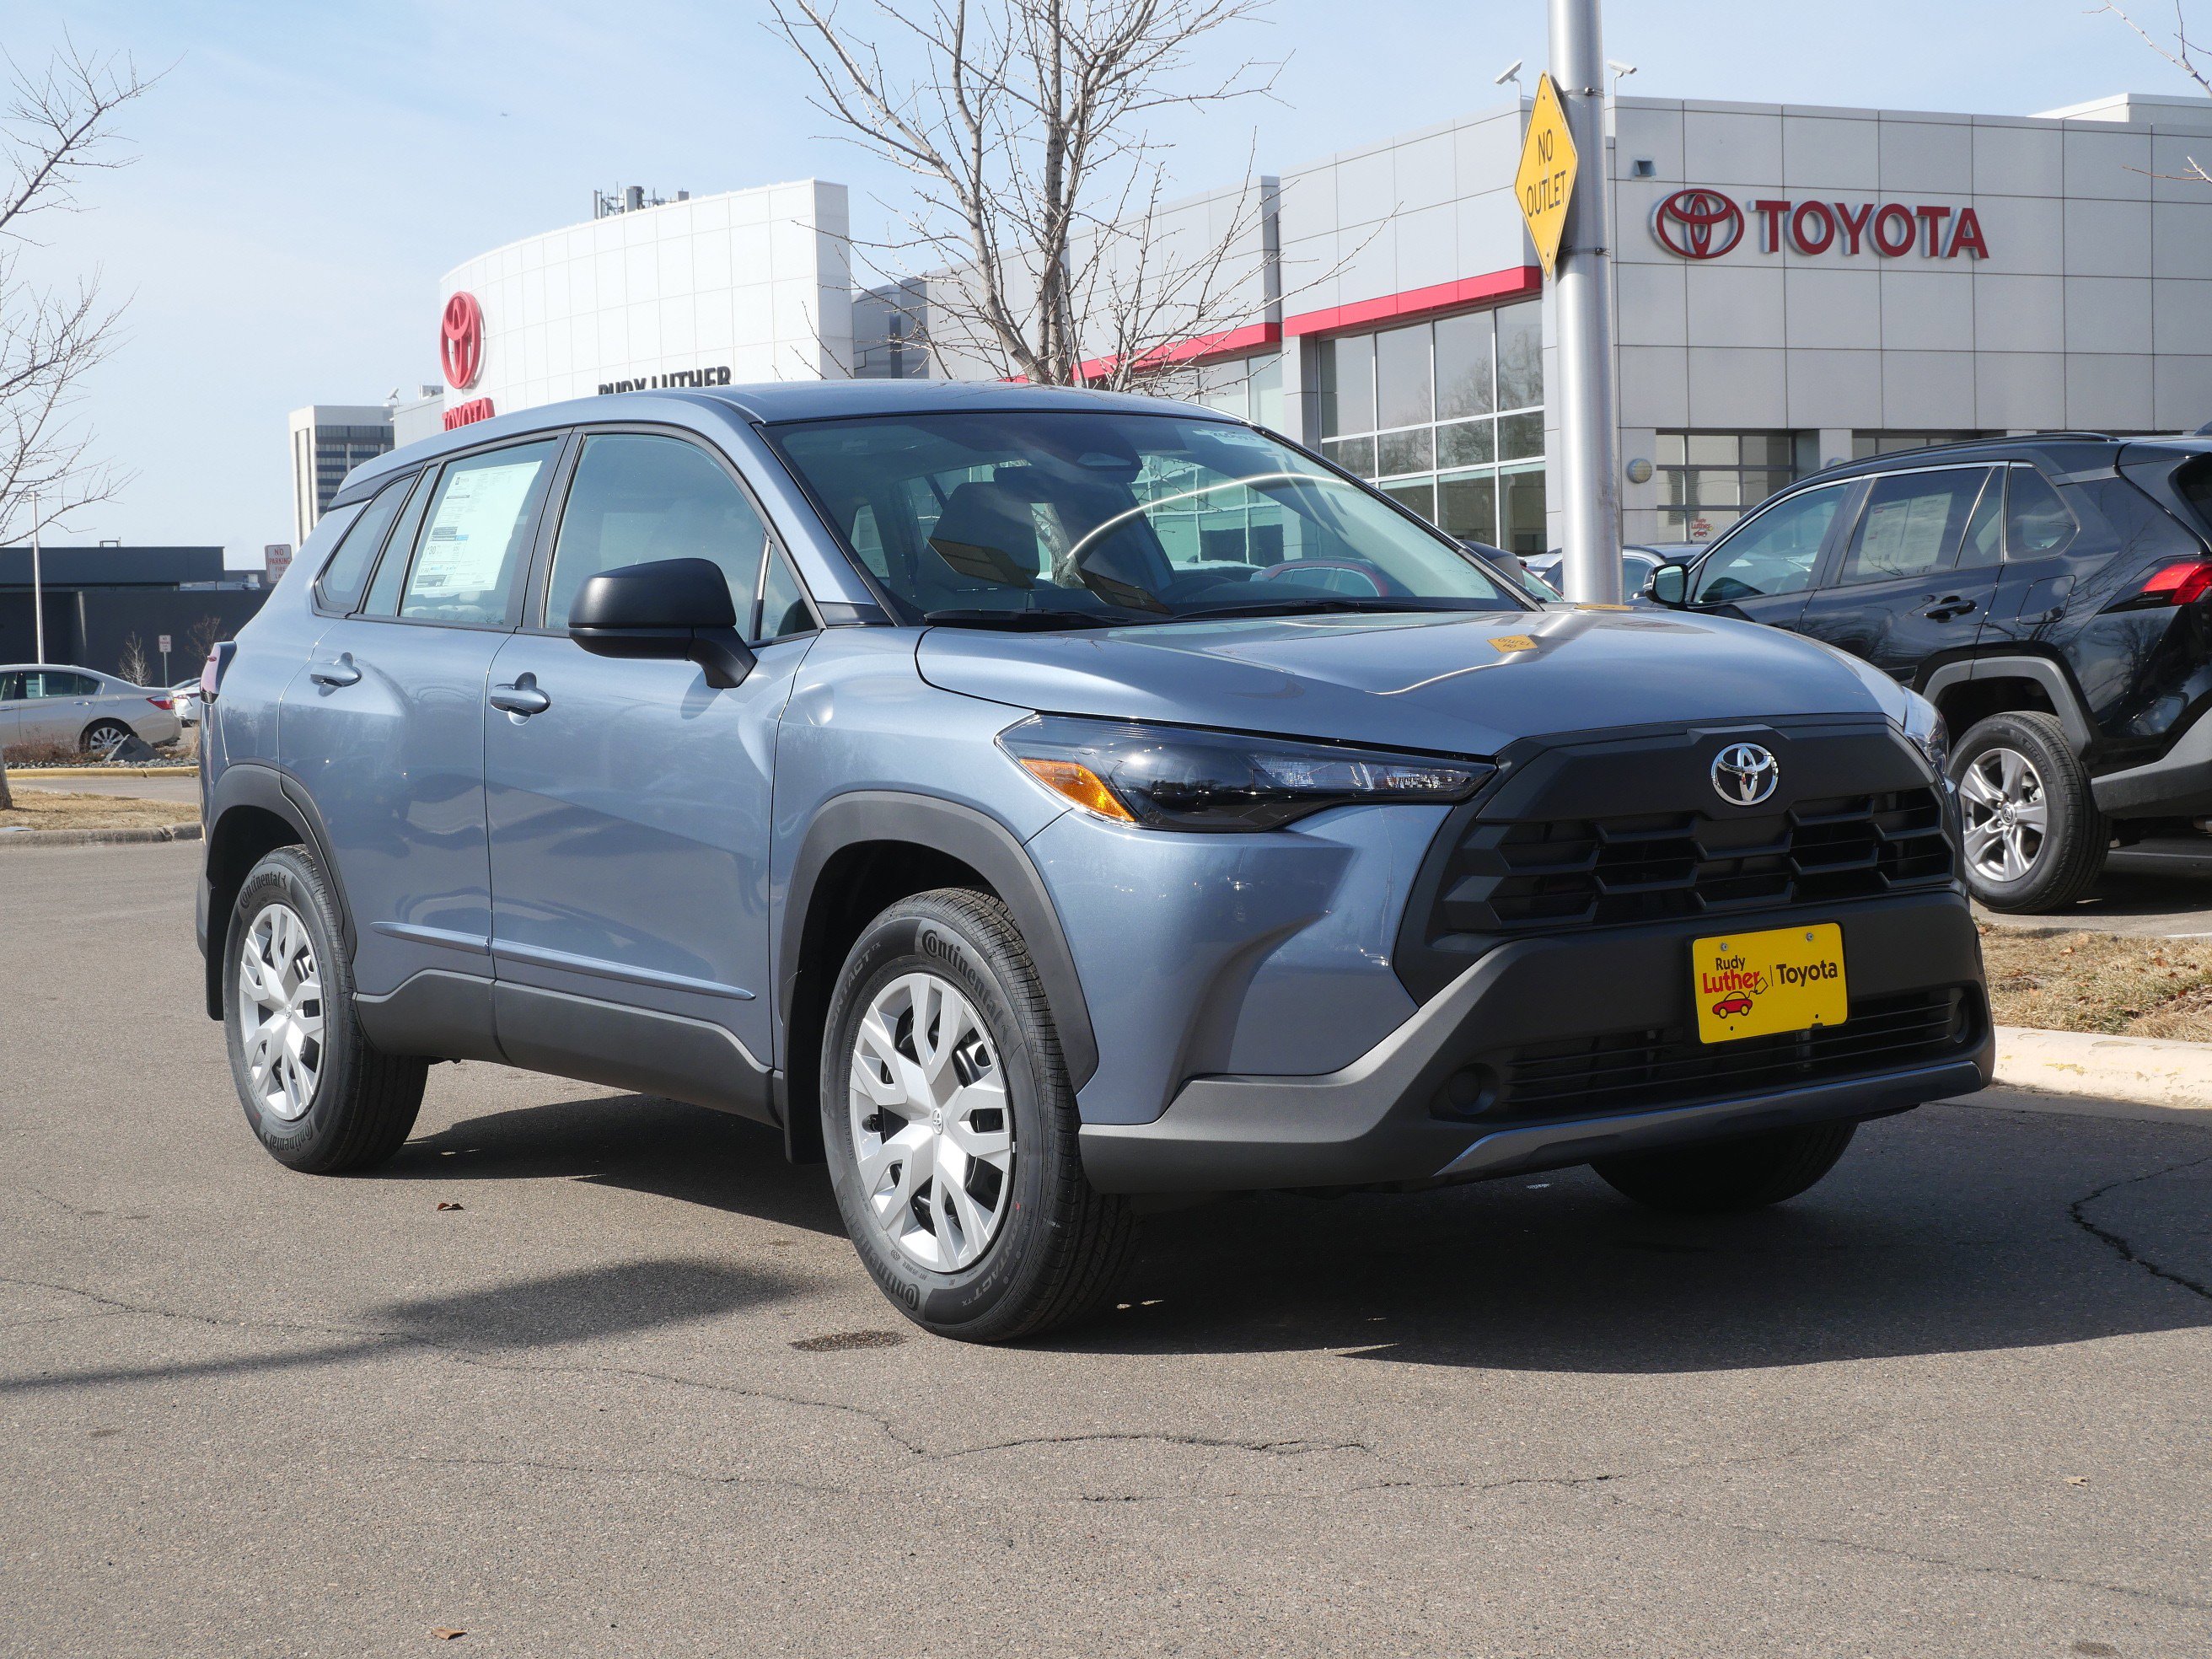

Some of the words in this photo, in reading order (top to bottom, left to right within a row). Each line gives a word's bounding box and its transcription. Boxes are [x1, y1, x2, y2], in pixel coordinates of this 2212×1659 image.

[1538, 129, 1554, 166] NO
[1527, 170, 1566, 217] OUTLET
[1752, 200, 1989, 259] TOYOTA
[442, 397, 495, 432] TOYOTA
[274, 548, 284, 556] NO
[239, 871, 282, 910] Continental
[921, 929, 1005, 1025] Continental
[1715, 955, 1746, 971] Rudy
[1775, 959, 1839, 987] Toyota
[1702, 969, 1760, 994] Luther
[269, 1119, 313, 1152] Continental
